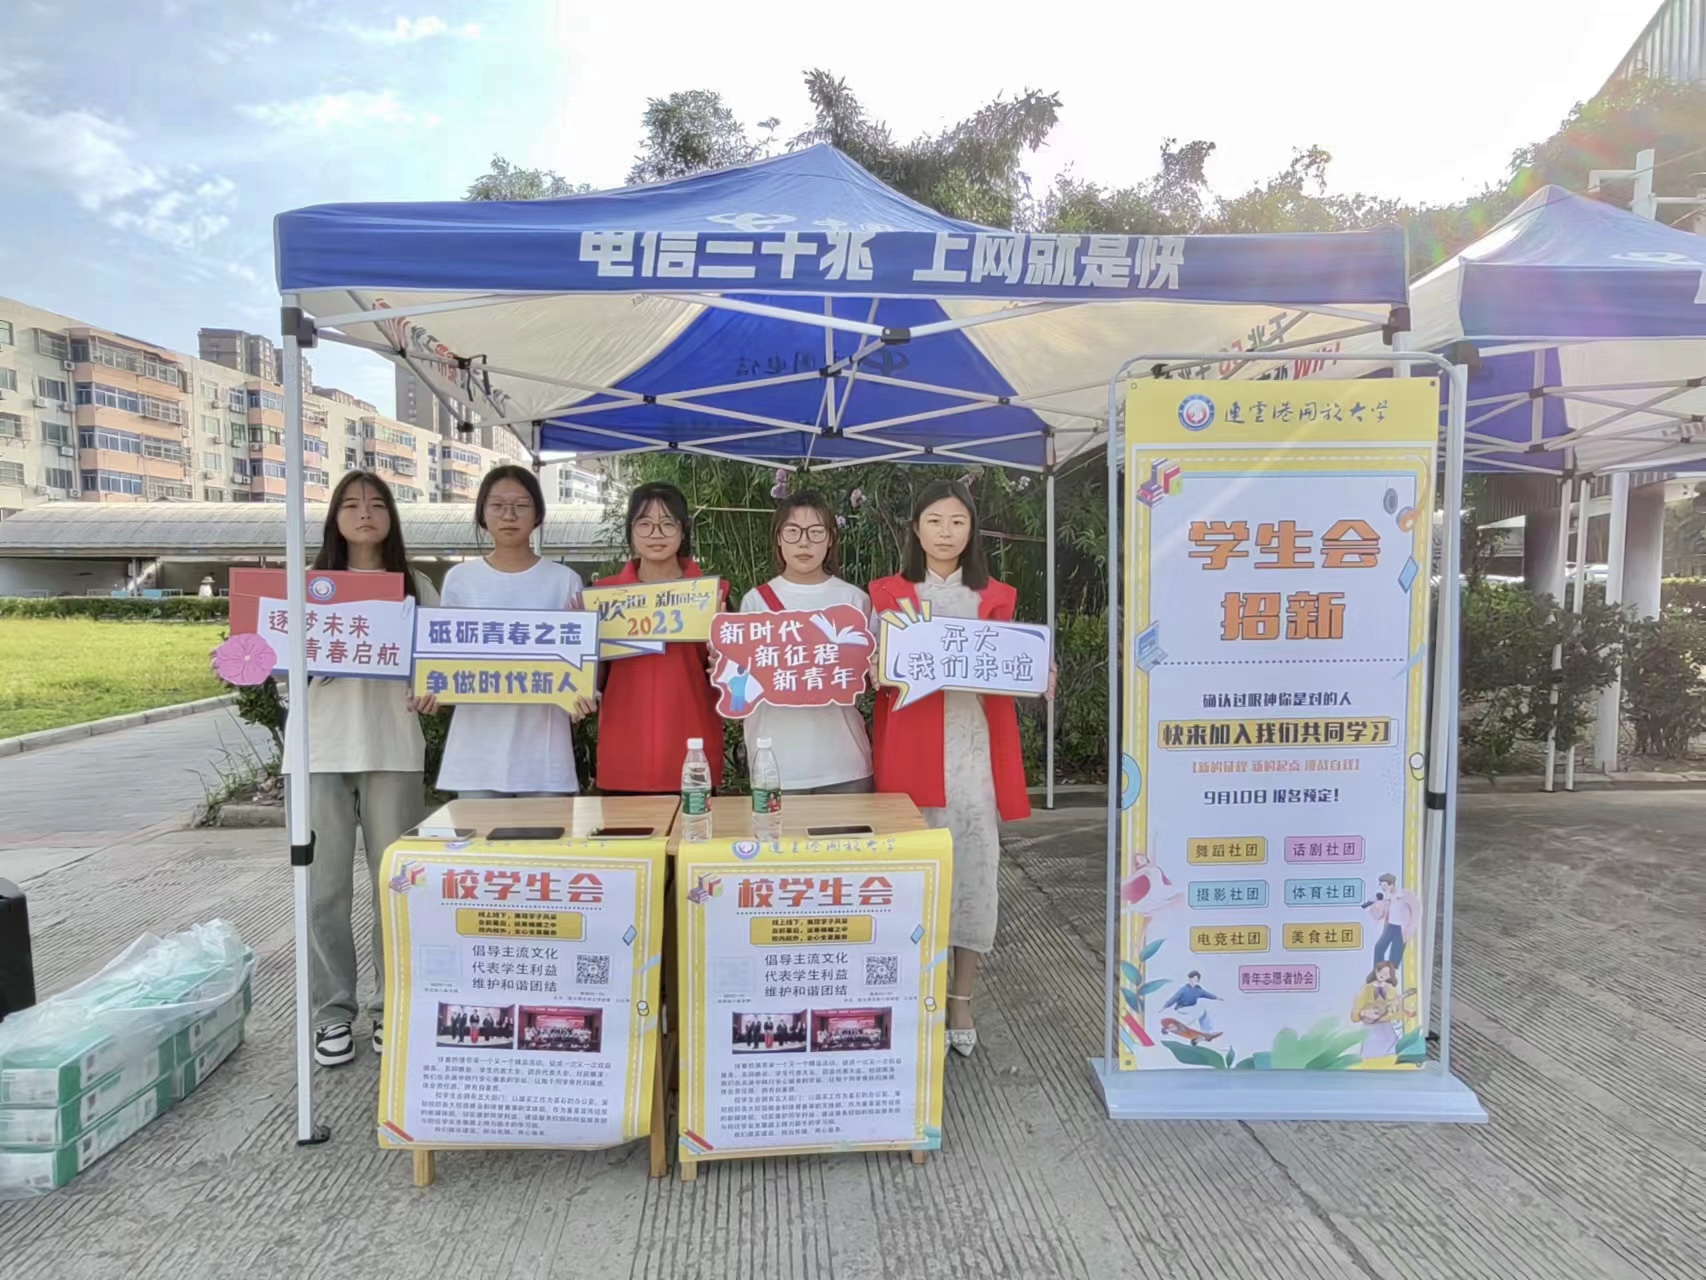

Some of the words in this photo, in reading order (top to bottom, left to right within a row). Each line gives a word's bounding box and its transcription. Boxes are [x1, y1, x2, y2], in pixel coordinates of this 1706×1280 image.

[912, 232, 1186, 289] 上网就是快
[1188, 519, 1381, 570] 学生会
[627, 609, 684, 636] 2023
[1220, 591, 1346, 641] 招新
[428, 620, 583, 646] 砥砺青春之志
[719, 619, 804, 645] 新时代
[941, 625, 999, 653] 开大
[754, 644, 841, 668] 新征程
[907, 651, 1034, 682] 我们来啦
[426, 669, 579, 695] 争做时代新人
[773, 668, 857, 691] 新青年
[1203, 691, 1352, 708] 确认过眼神你是对的人
[1163, 720, 1390, 747] 快来加入我们共同学习
[1204, 789, 1267, 805] 9月10日
[1195, 843, 1258, 858] 舞蹈社团
[1293, 842, 1356, 857] 话剧社团
[441, 868, 605, 904] 校学生会
[737, 875, 894, 908] 校学生会
[1196, 887, 1259, 902] 摄影社团
[1293, 885, 1355, 899] 体育社团
[1197, 931, 1261, 946] 电竞社团
[1291, 929, 1354, 944] 美食社团
[472, 944, 559, 960] 倡导主流文化
[764, 951, 848, 966] 倡导主流文化
[472, 961, 558, 976] 代表学生利益
[764, 968, 848, 982] 代表学生利益
[472, 977, 558, 992] 维护和谐团结
[1241, 970, 1315, 986] 青年志愿者协会
[764, 984, 848, 997] 维护和谐团结
